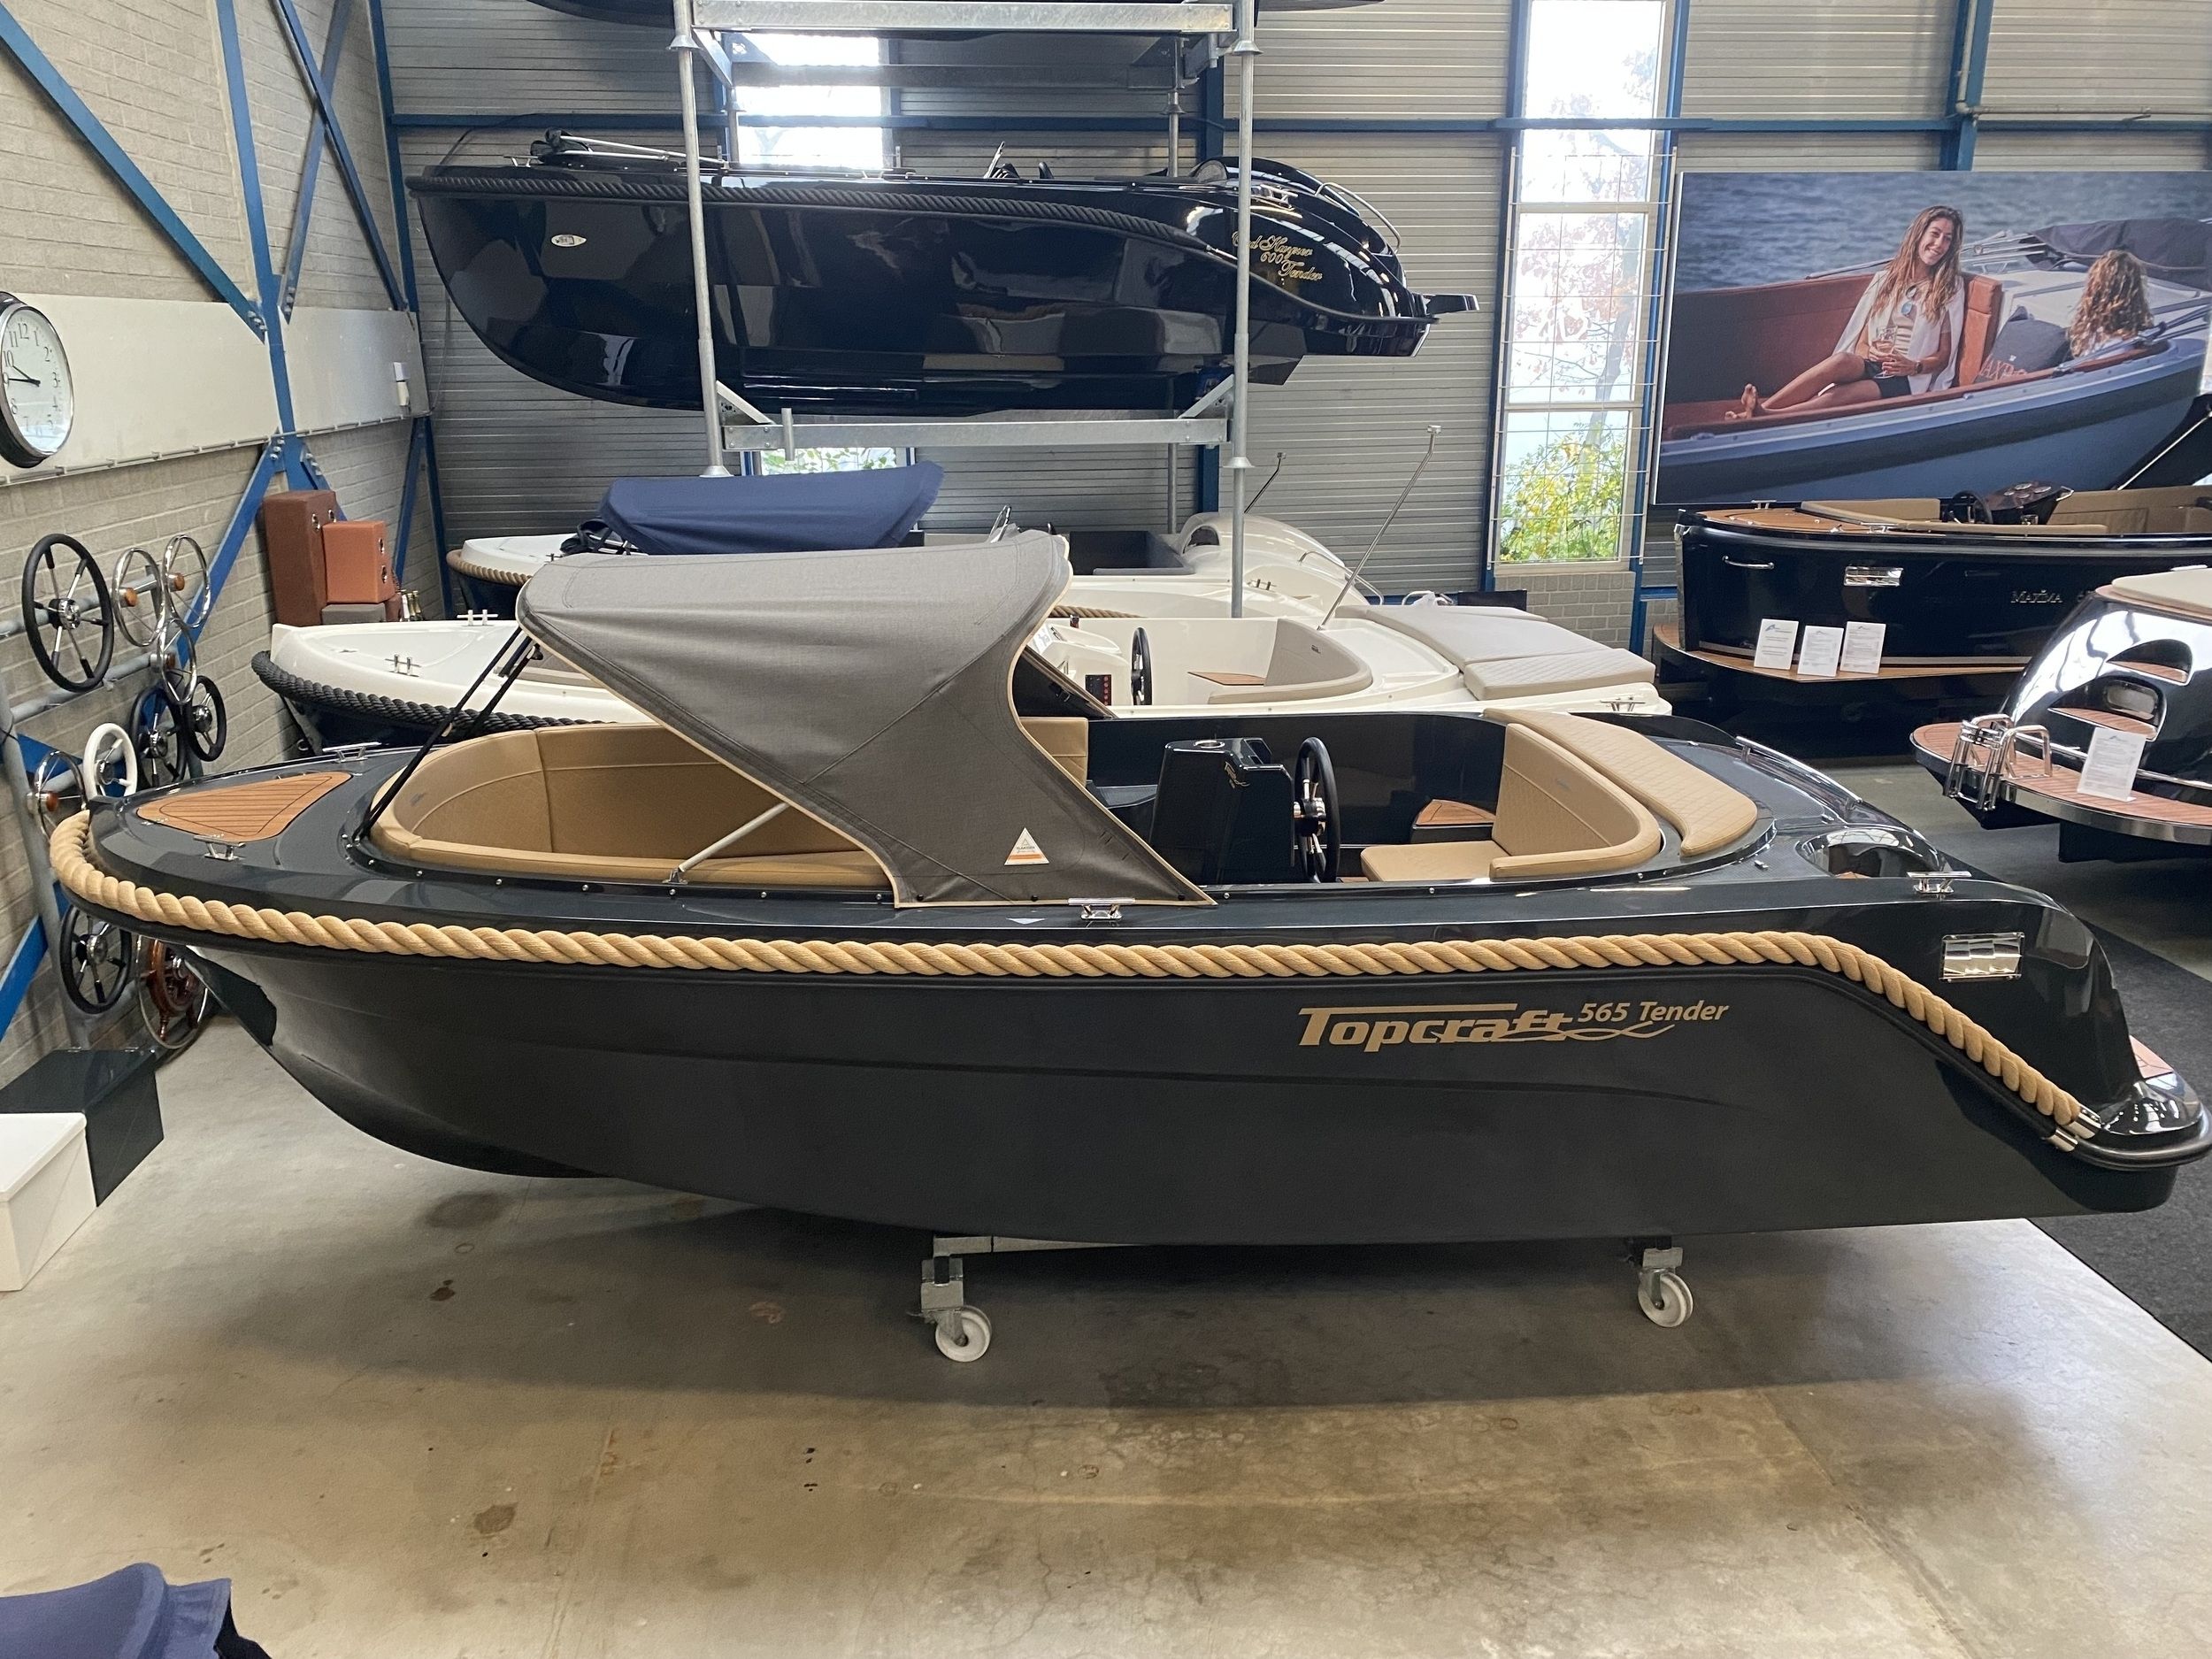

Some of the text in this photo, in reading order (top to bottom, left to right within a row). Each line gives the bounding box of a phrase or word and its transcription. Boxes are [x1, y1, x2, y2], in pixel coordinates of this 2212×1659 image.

[1260, 250, 1284, 265] 600
[1278, 260, 1323, 281] Tender
[9, 331, 19, 348] 11
[18, 322, 29, 340] 12
[34, 330, 39, 347] 1
[3, 349, 14, 368] 10
[43, 346, 50, 362] 2
[52, 372, 58, 388] 3
[11, 397, 18, 415] 8
[1298, 1000, 1730, 1053] Topcraft 565 Tender
